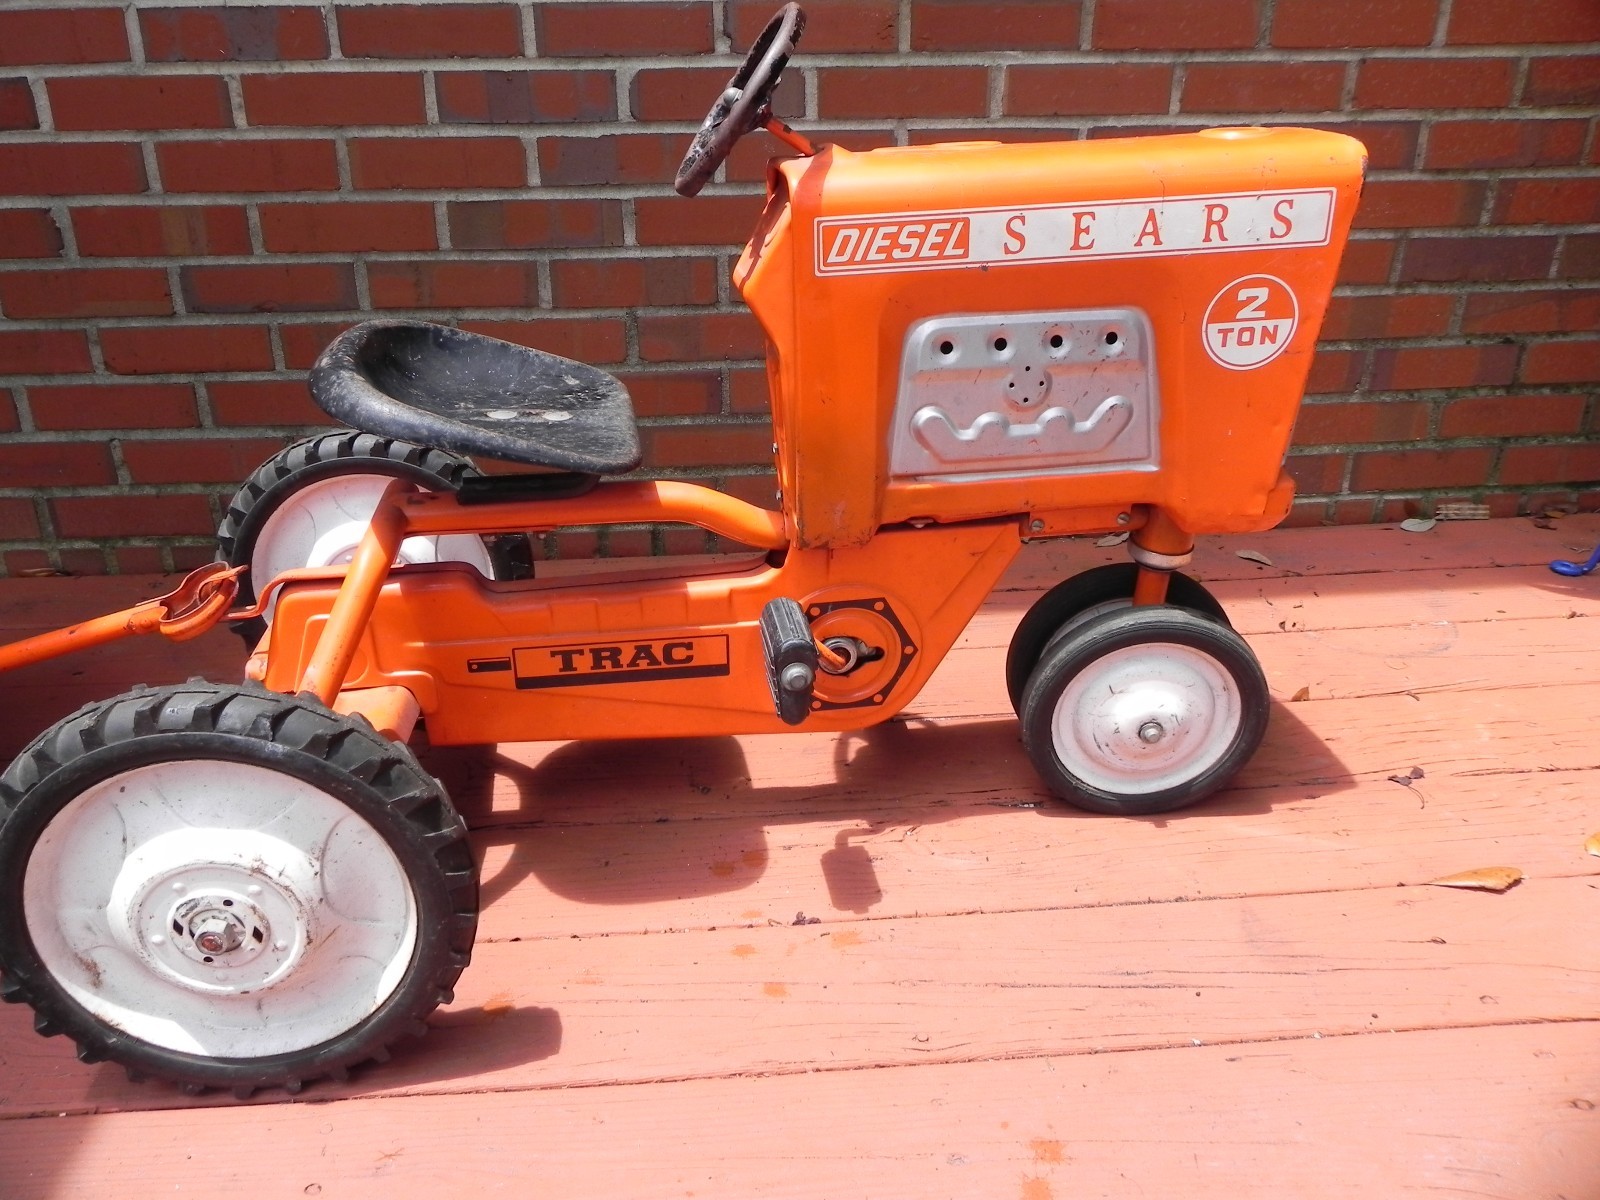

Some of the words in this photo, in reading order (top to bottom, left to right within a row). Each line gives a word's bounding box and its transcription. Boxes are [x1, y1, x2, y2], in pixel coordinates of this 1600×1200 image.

[826, 221, 965, 263] DIESEL
[1003, 199, 1294, 255] SEARS
[1235, 286, 1270, 320] 2
[1217, 324, 1279, 348] TON
[550, 641, 694, 672] TRAC
